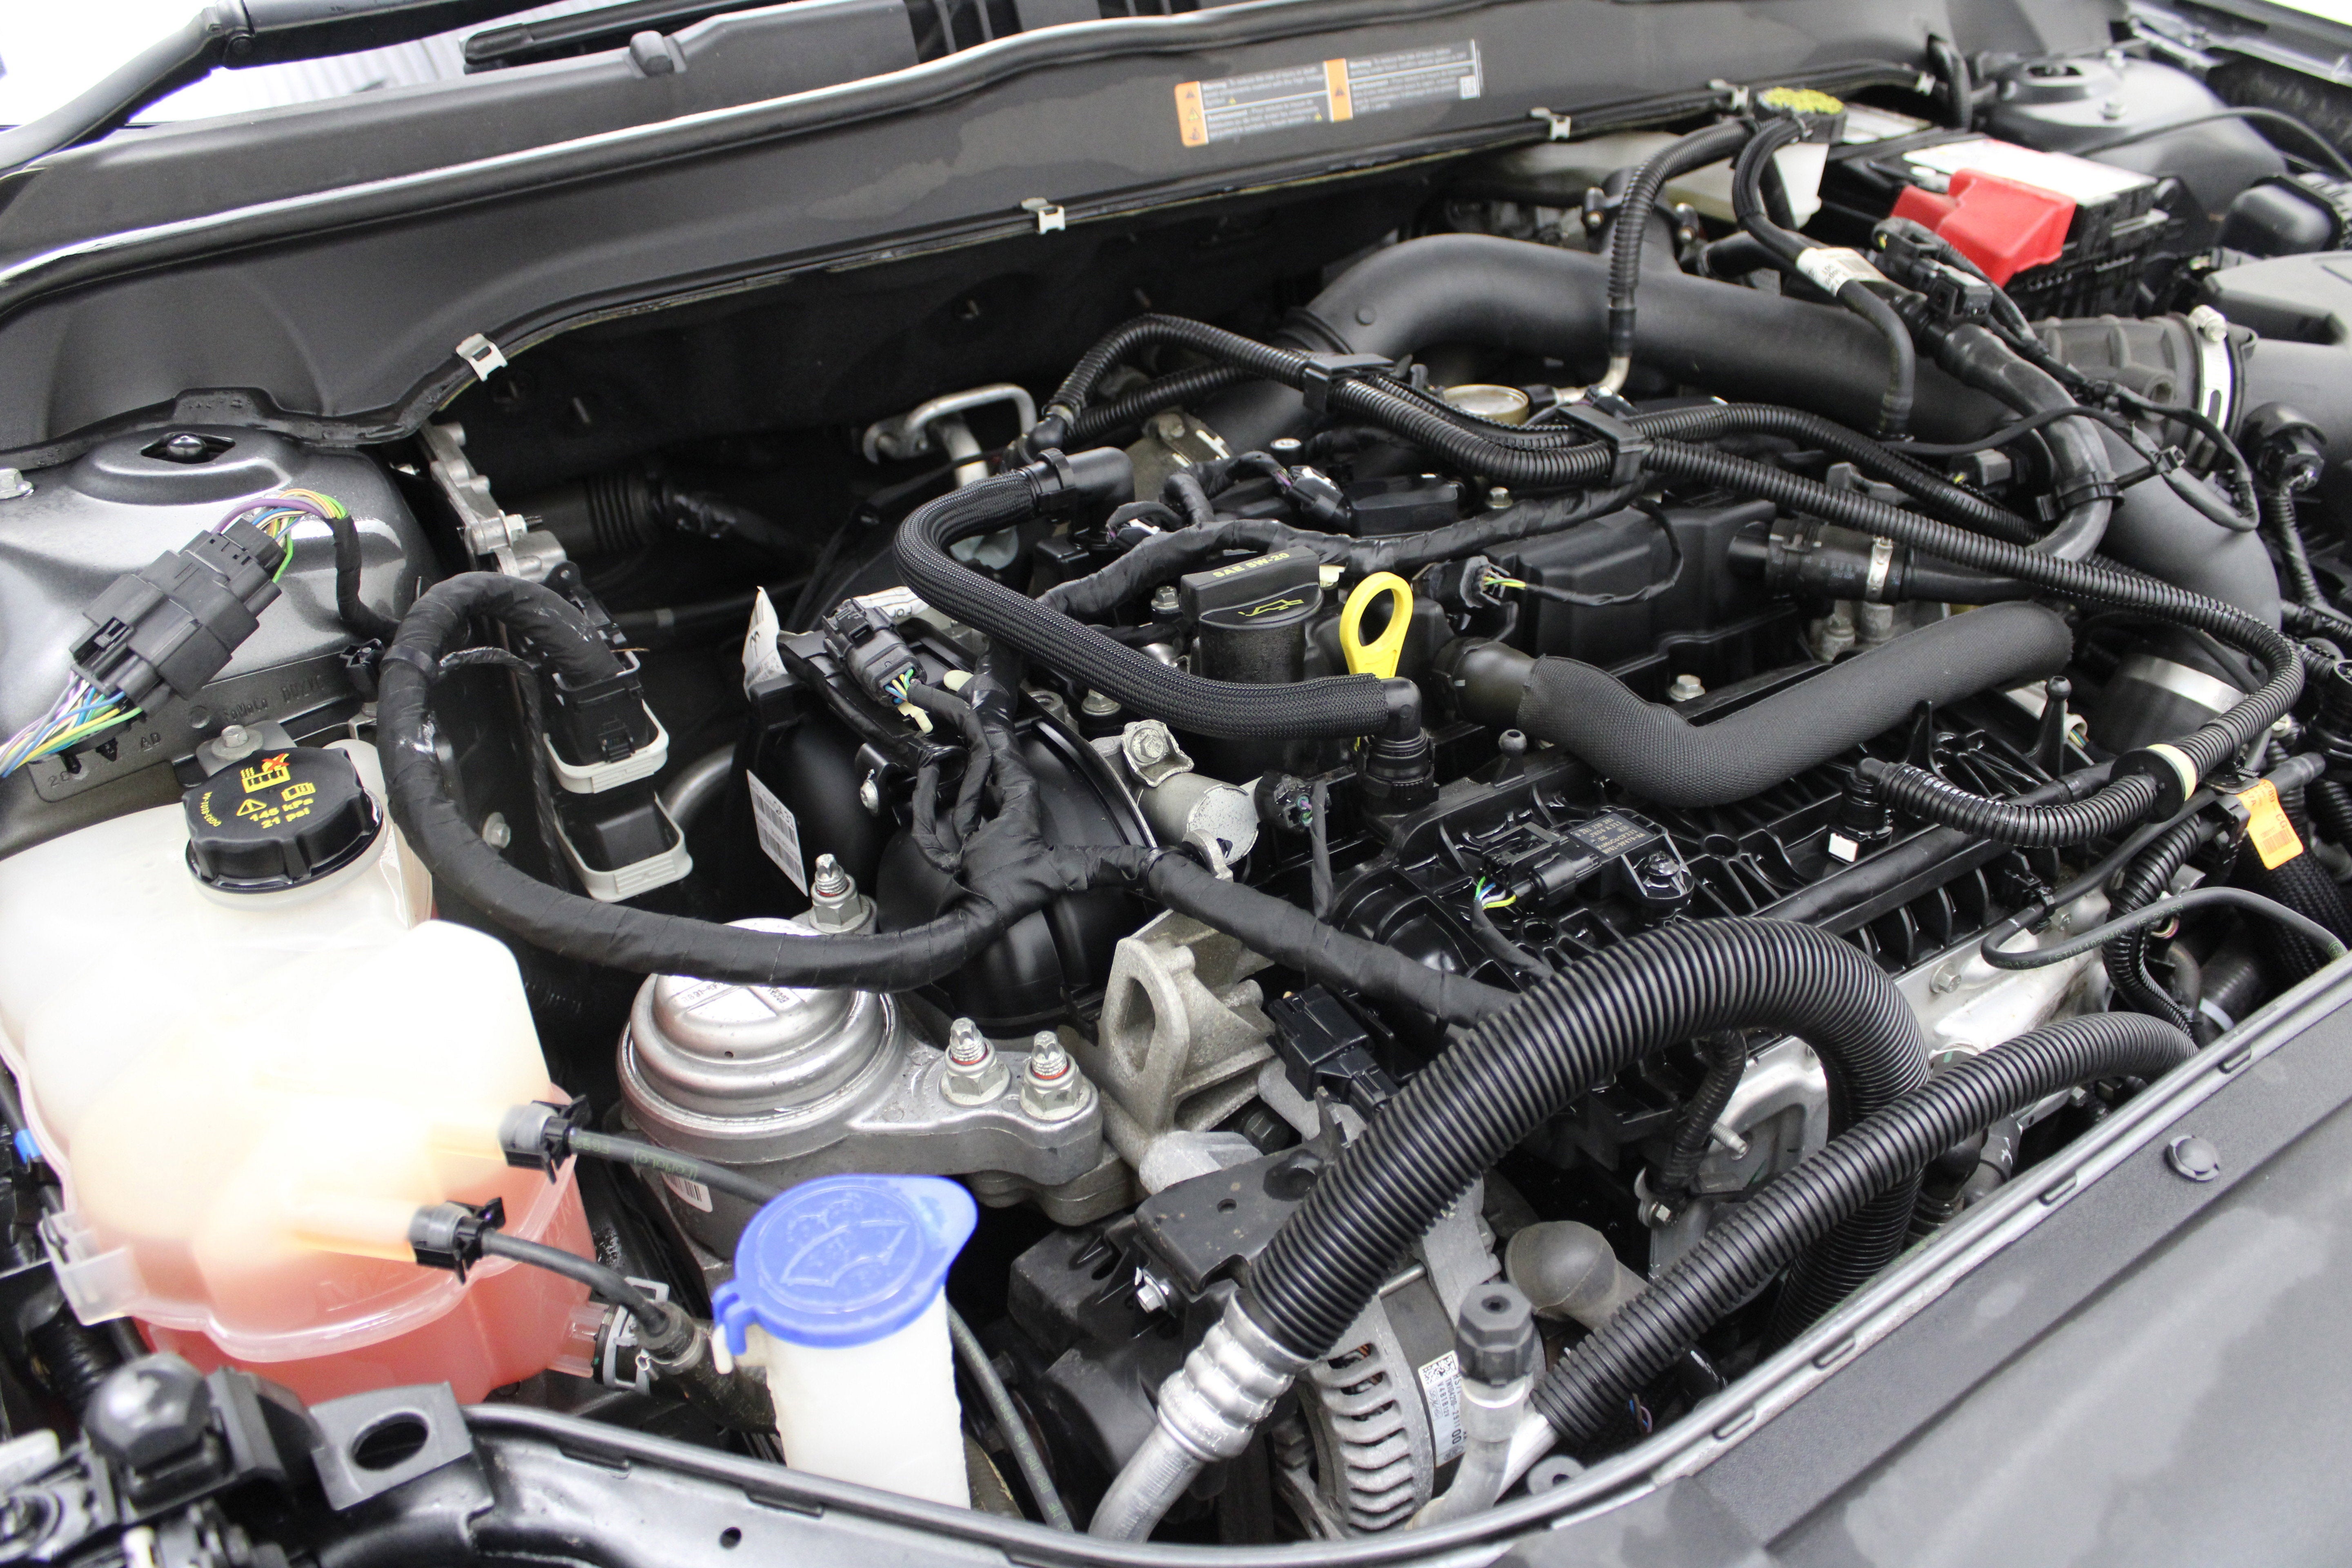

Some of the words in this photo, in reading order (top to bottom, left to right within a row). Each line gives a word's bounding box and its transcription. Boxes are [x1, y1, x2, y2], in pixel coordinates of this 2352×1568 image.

[1213, 565, 1245, 578] SAE
[1245, 552, 1290, 569] 5W-20
[199, 791, 223, 828] DG93-8101-AA
[249, 806, 280, 822] 145
[282, 797, 315, 812] kPa
[261, 816, 281, 829] 21
[285, 807, 311, 822] psi
